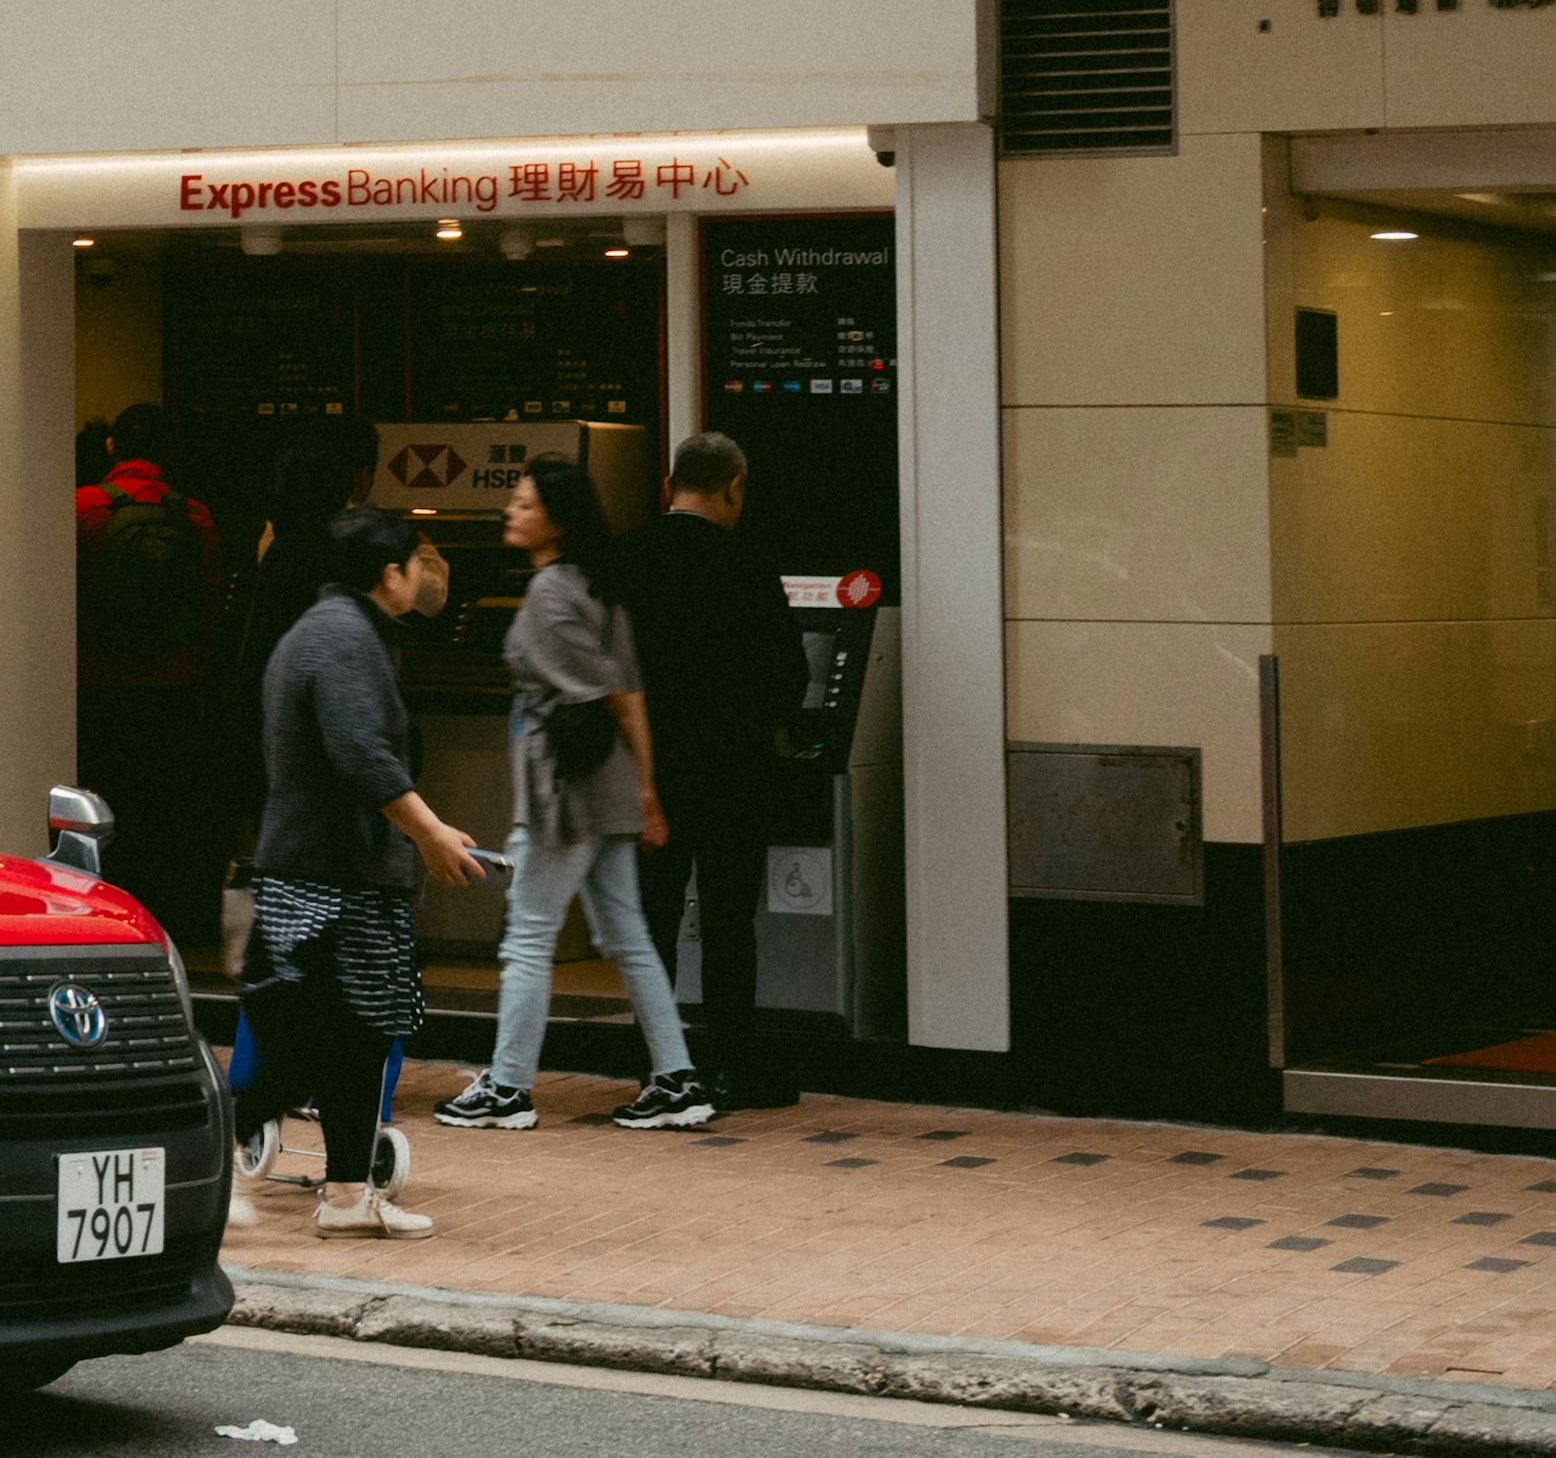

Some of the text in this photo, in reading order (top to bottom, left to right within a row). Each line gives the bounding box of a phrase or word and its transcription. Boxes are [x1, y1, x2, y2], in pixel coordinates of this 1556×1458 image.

[507, 157, 750, 204] 理財易中心
[721, 247, 888, 267] Cash Withdrawal
[722, 272, 819, 295] 現金提款
[472, 469, 522, 489] HSB
[92, 1153, 135, 1205] YH
[67, 1203, 156, 1260] 7907
